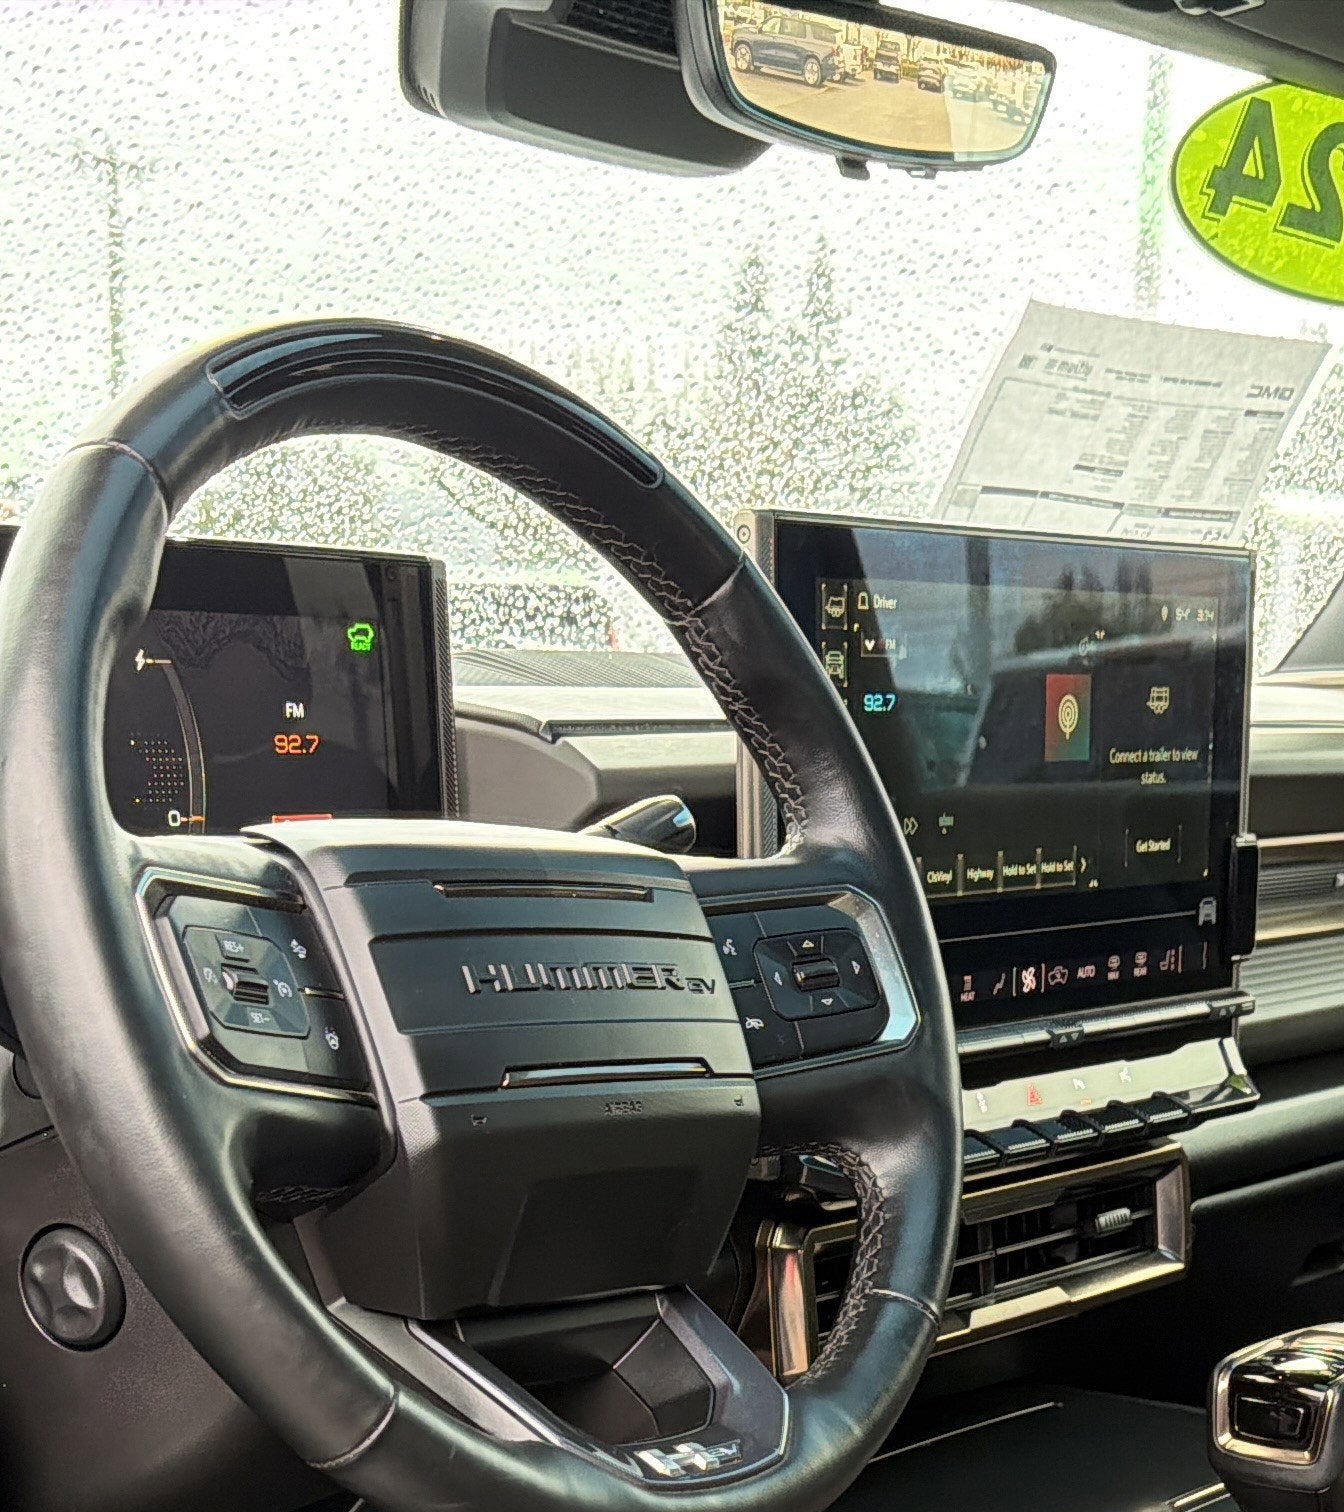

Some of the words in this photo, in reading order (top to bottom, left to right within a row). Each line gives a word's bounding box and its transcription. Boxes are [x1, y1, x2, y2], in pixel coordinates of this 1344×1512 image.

[285, 700, 305, 719] FM
[863, 693, 896, 711] 92.7
[273, 733, 320, 754] 92.7
[1109, 747, 1142, 764] Connect
[1143, 750, 1149, 762] a
[1149, 746, 1171, 762] trailer
[1172, 748, 1181, 762] to
[1181, 746, 1199, 761] view
[1140, 771, 1167, 785] status.
[1136, 840, 1148, 853] Get
[1149, 838, 1172, 852] Started
[1003, 864, 1017, 877] Hold
[1018, 865, 1026, 876] to
[1026, 862, 1037, 875] Set
[1040, 862, 1056, 874] Hold
[1056, 861, 1063, 872] to
[1064, 860, 1075, 872] Set
[966, 868, 994, 883] Highway
[461, 962, 685, 994] HUMMER
[1076, 965, 1096, 979] AUTO
